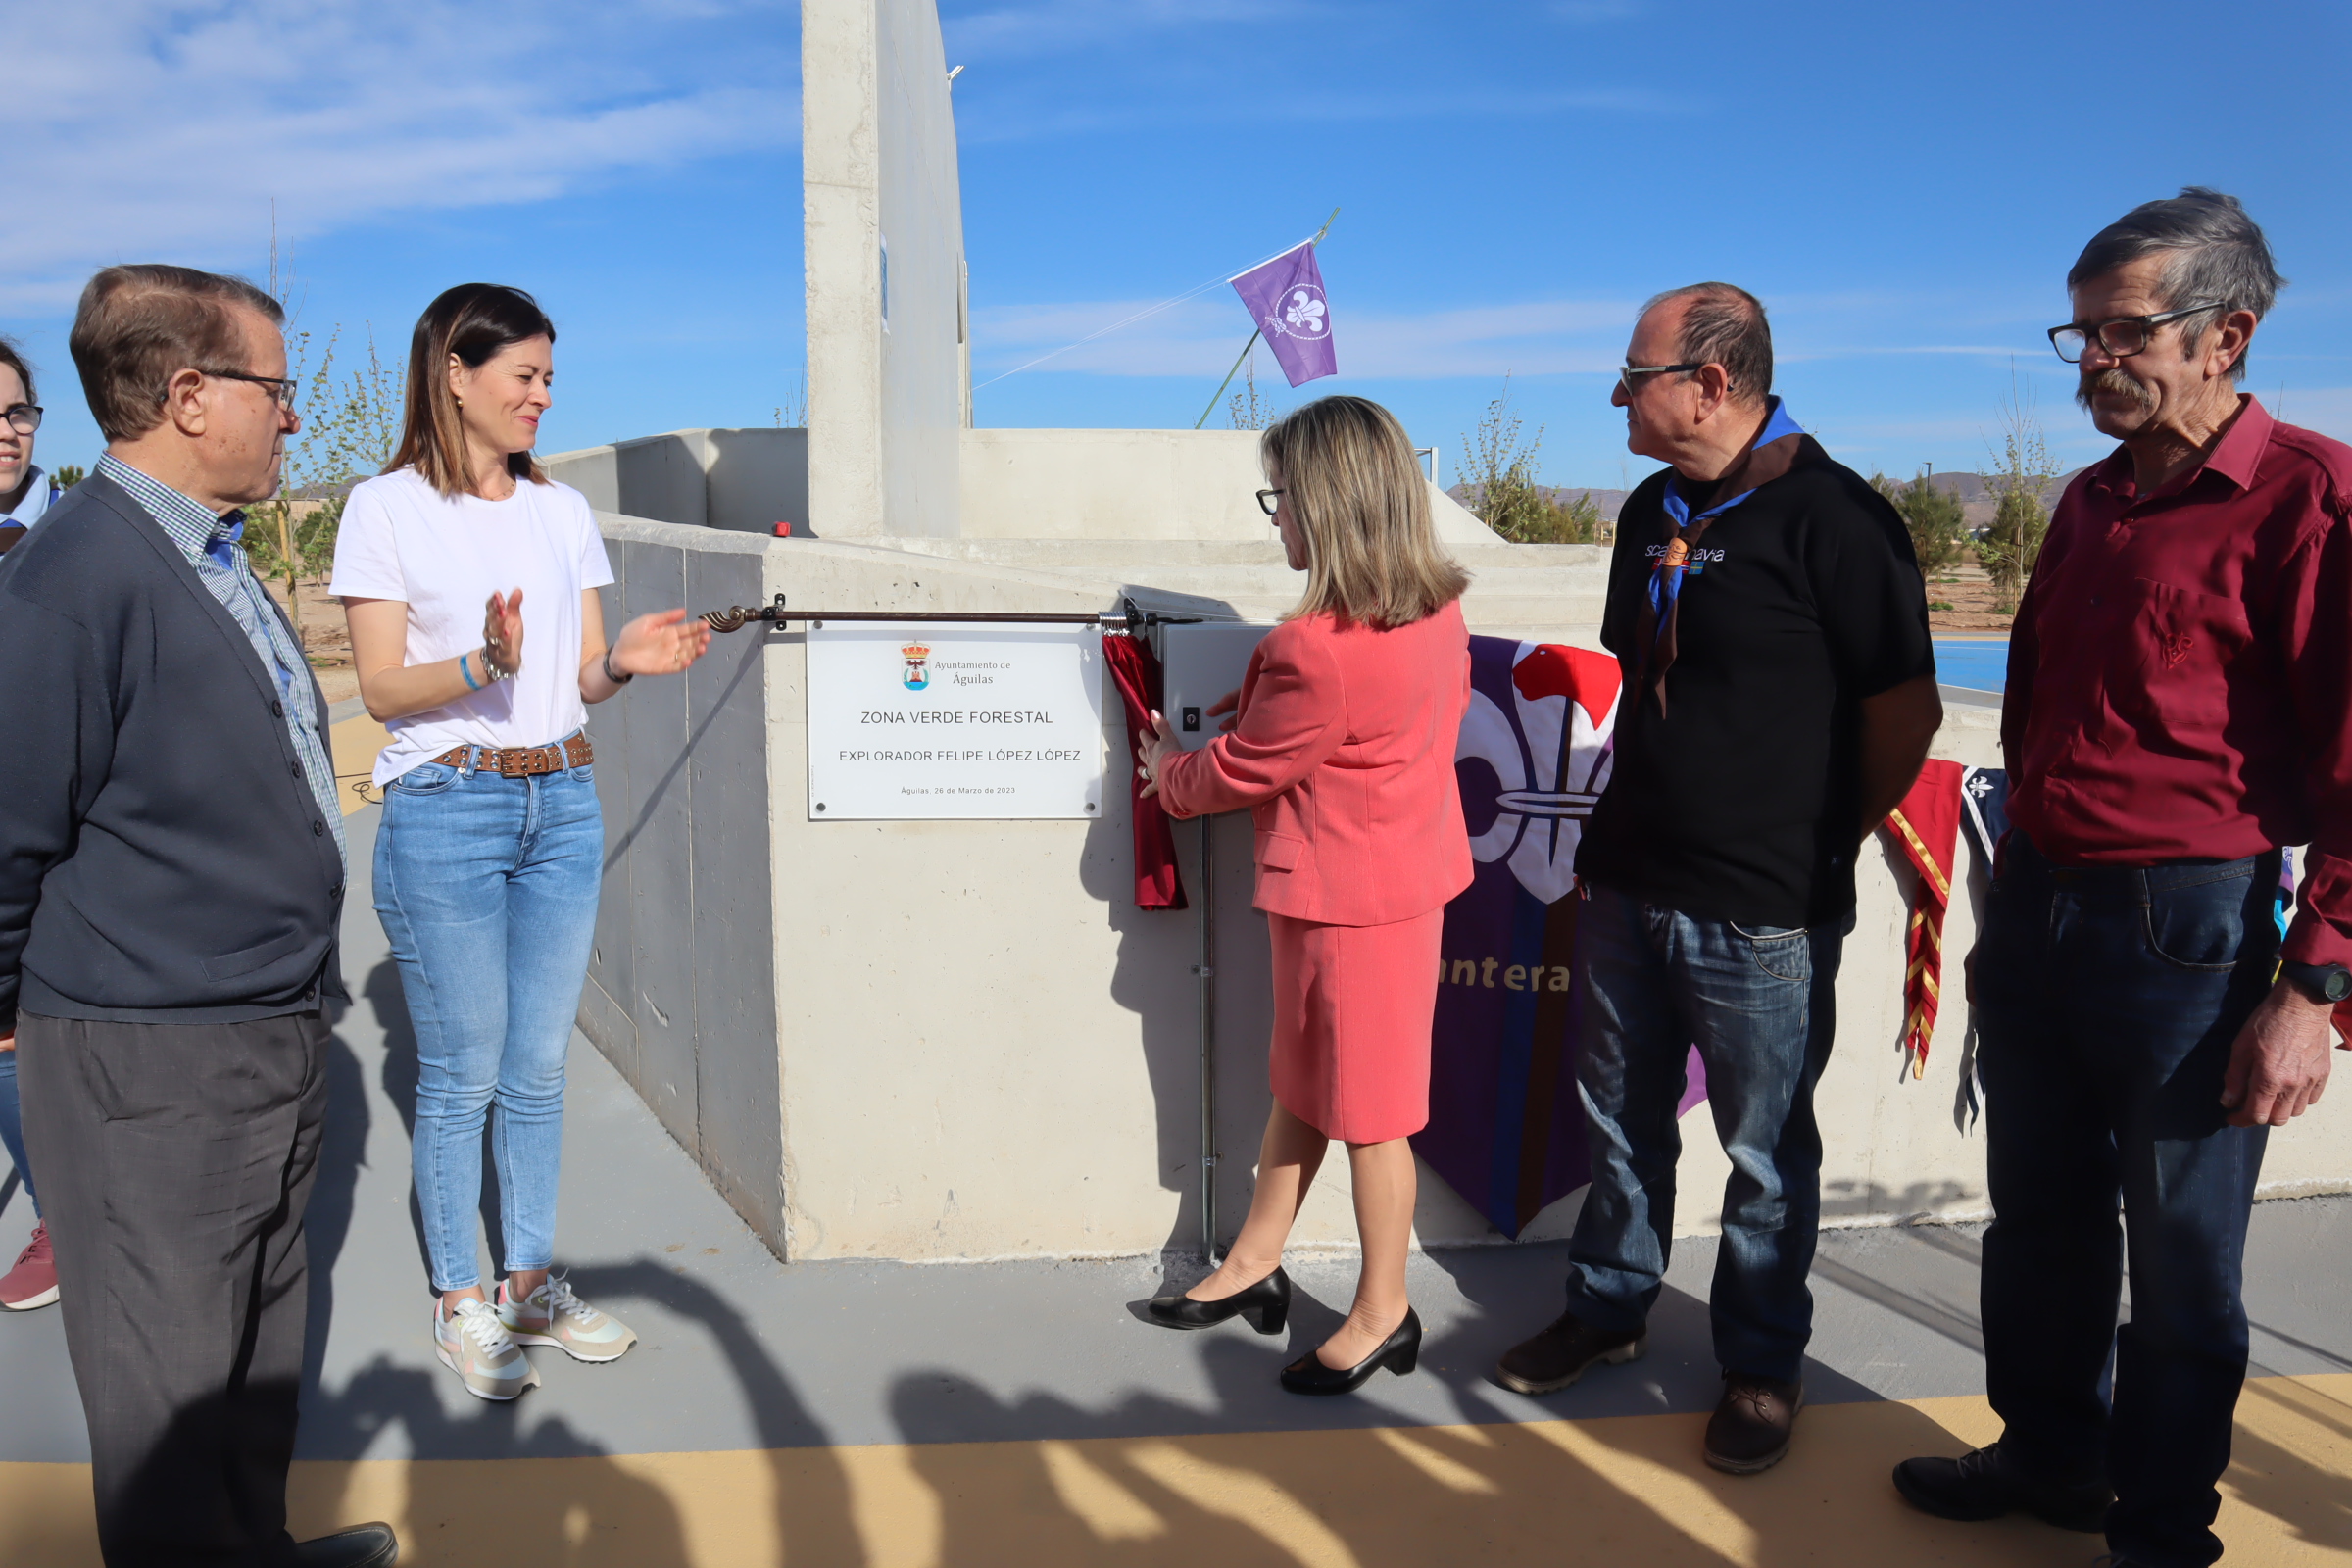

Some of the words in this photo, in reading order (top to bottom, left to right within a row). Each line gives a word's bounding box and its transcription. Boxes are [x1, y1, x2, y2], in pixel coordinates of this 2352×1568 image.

[1644, 544, 1725, 562] scanavia
[934, 661, 998, 670] Ayuntamiento
[1000, 661, 1011, 669] de
[953, 671, 994, 687] Águilas
[860, 711, 906, 724] ZONA
[909, 711, 964, 724] VERDE
[969, 711, 1054, 724] FORESTAL
[839, 750, 933, 761] EXPLORADOR
[937, 750, 984, 761] FELIPE
[988, 748, 1033, 761] LÓPEZ
[1037, 748, 1081, 760] LÓPEZ
[901, 786, 932, 796] Águilas,
